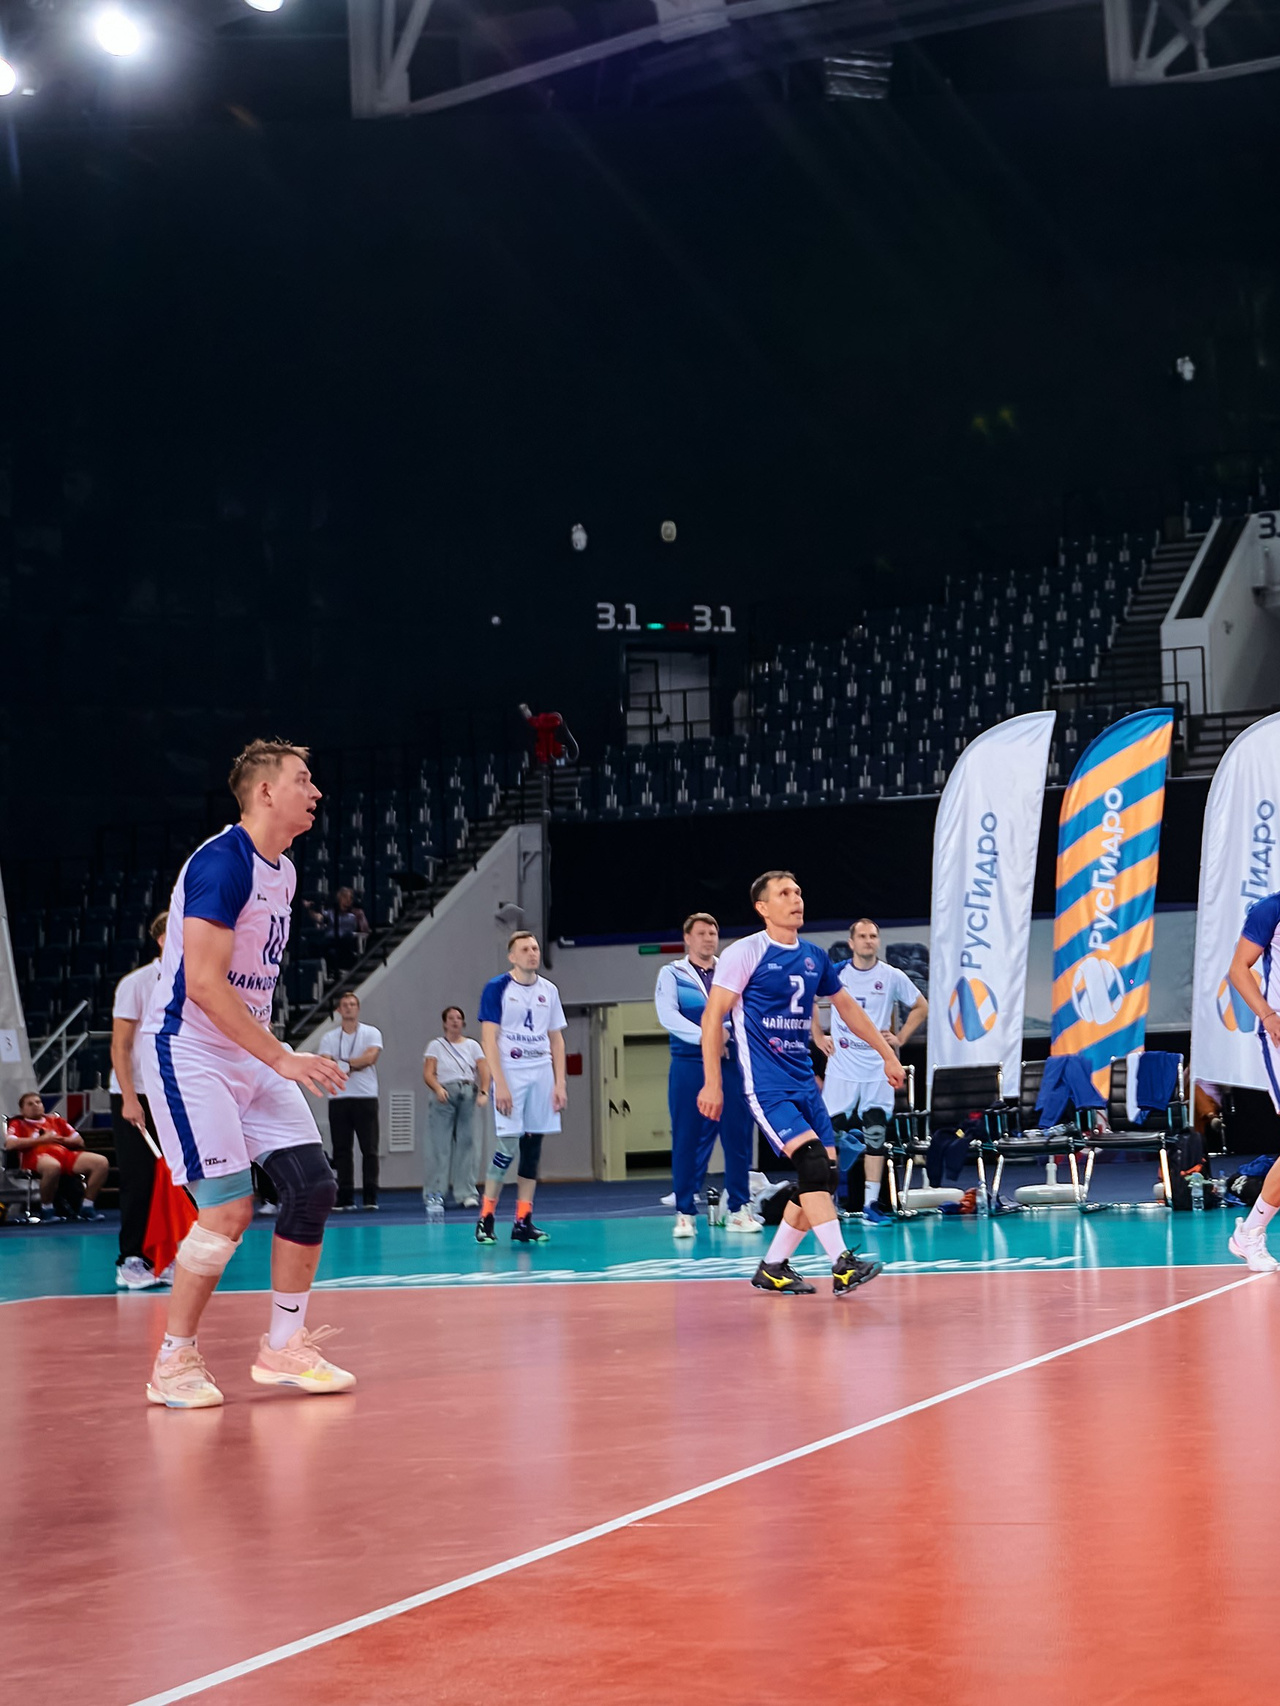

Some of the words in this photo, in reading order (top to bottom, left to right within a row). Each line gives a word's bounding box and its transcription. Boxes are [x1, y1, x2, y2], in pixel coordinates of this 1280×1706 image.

[596, 602, 641, 630] 3.1
[693, 604, 736, 632] 3.1
[1088, 786, 1125, 952] РусГидро
[960, 811, 999, 970] РусГидро
[788, 974, 805, 1015] 2
[523, 1008, 535, 1032] 4
